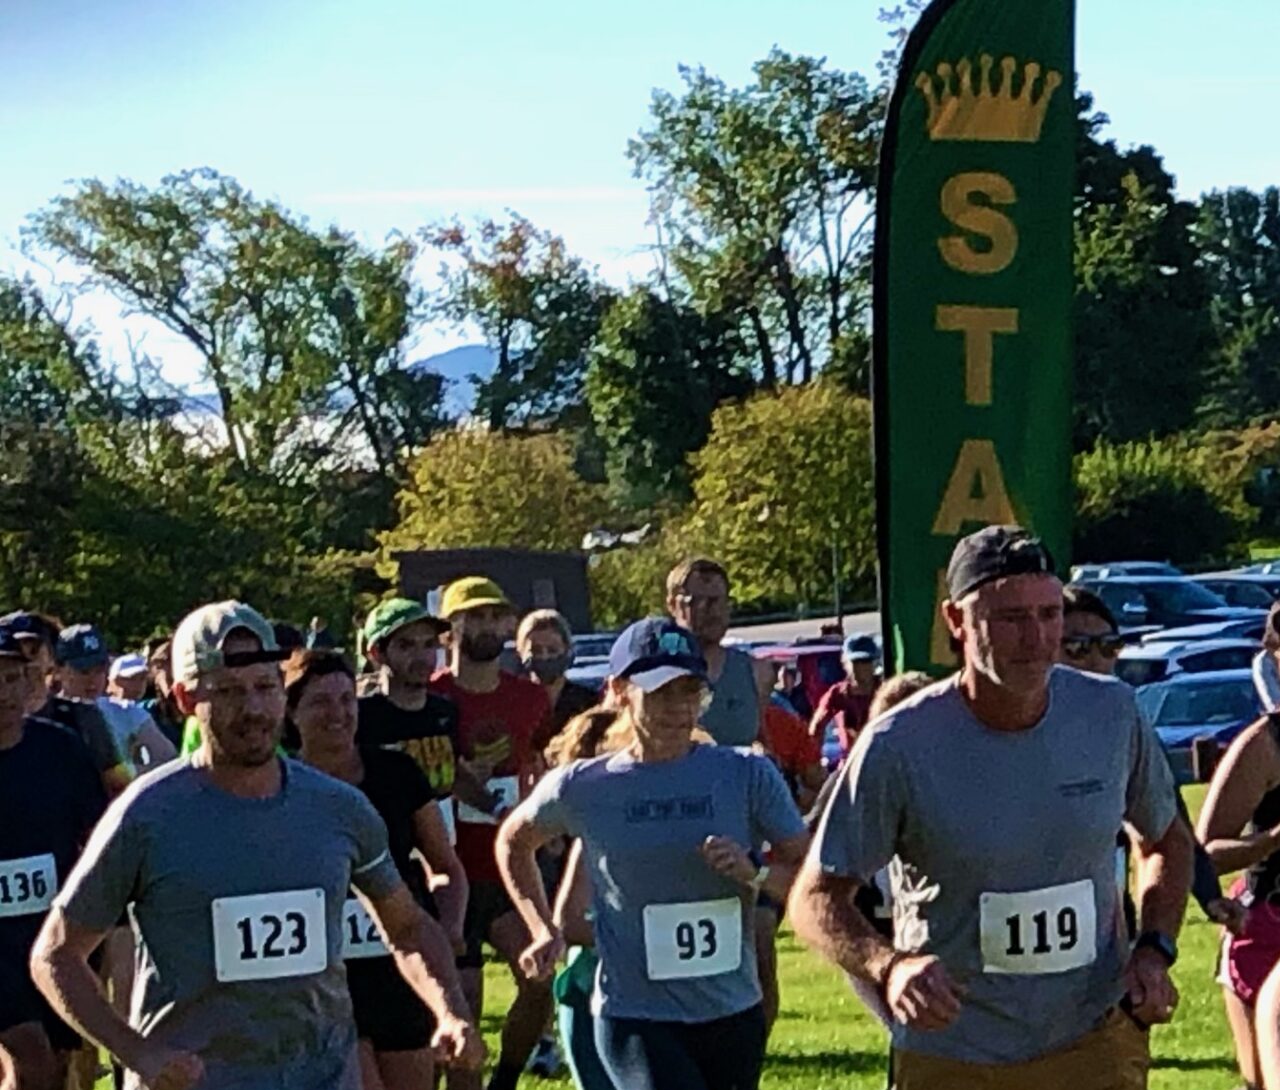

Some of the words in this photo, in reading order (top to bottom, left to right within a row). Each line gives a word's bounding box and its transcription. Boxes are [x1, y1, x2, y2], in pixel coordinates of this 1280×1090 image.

[930, 172, 1020, 666] STA
[0, 870, 47, 904] 136
[237, 912, 307, 960] 123
[676, 918, 717, 960] 93
[1006, 906, 1078, 955] 119
